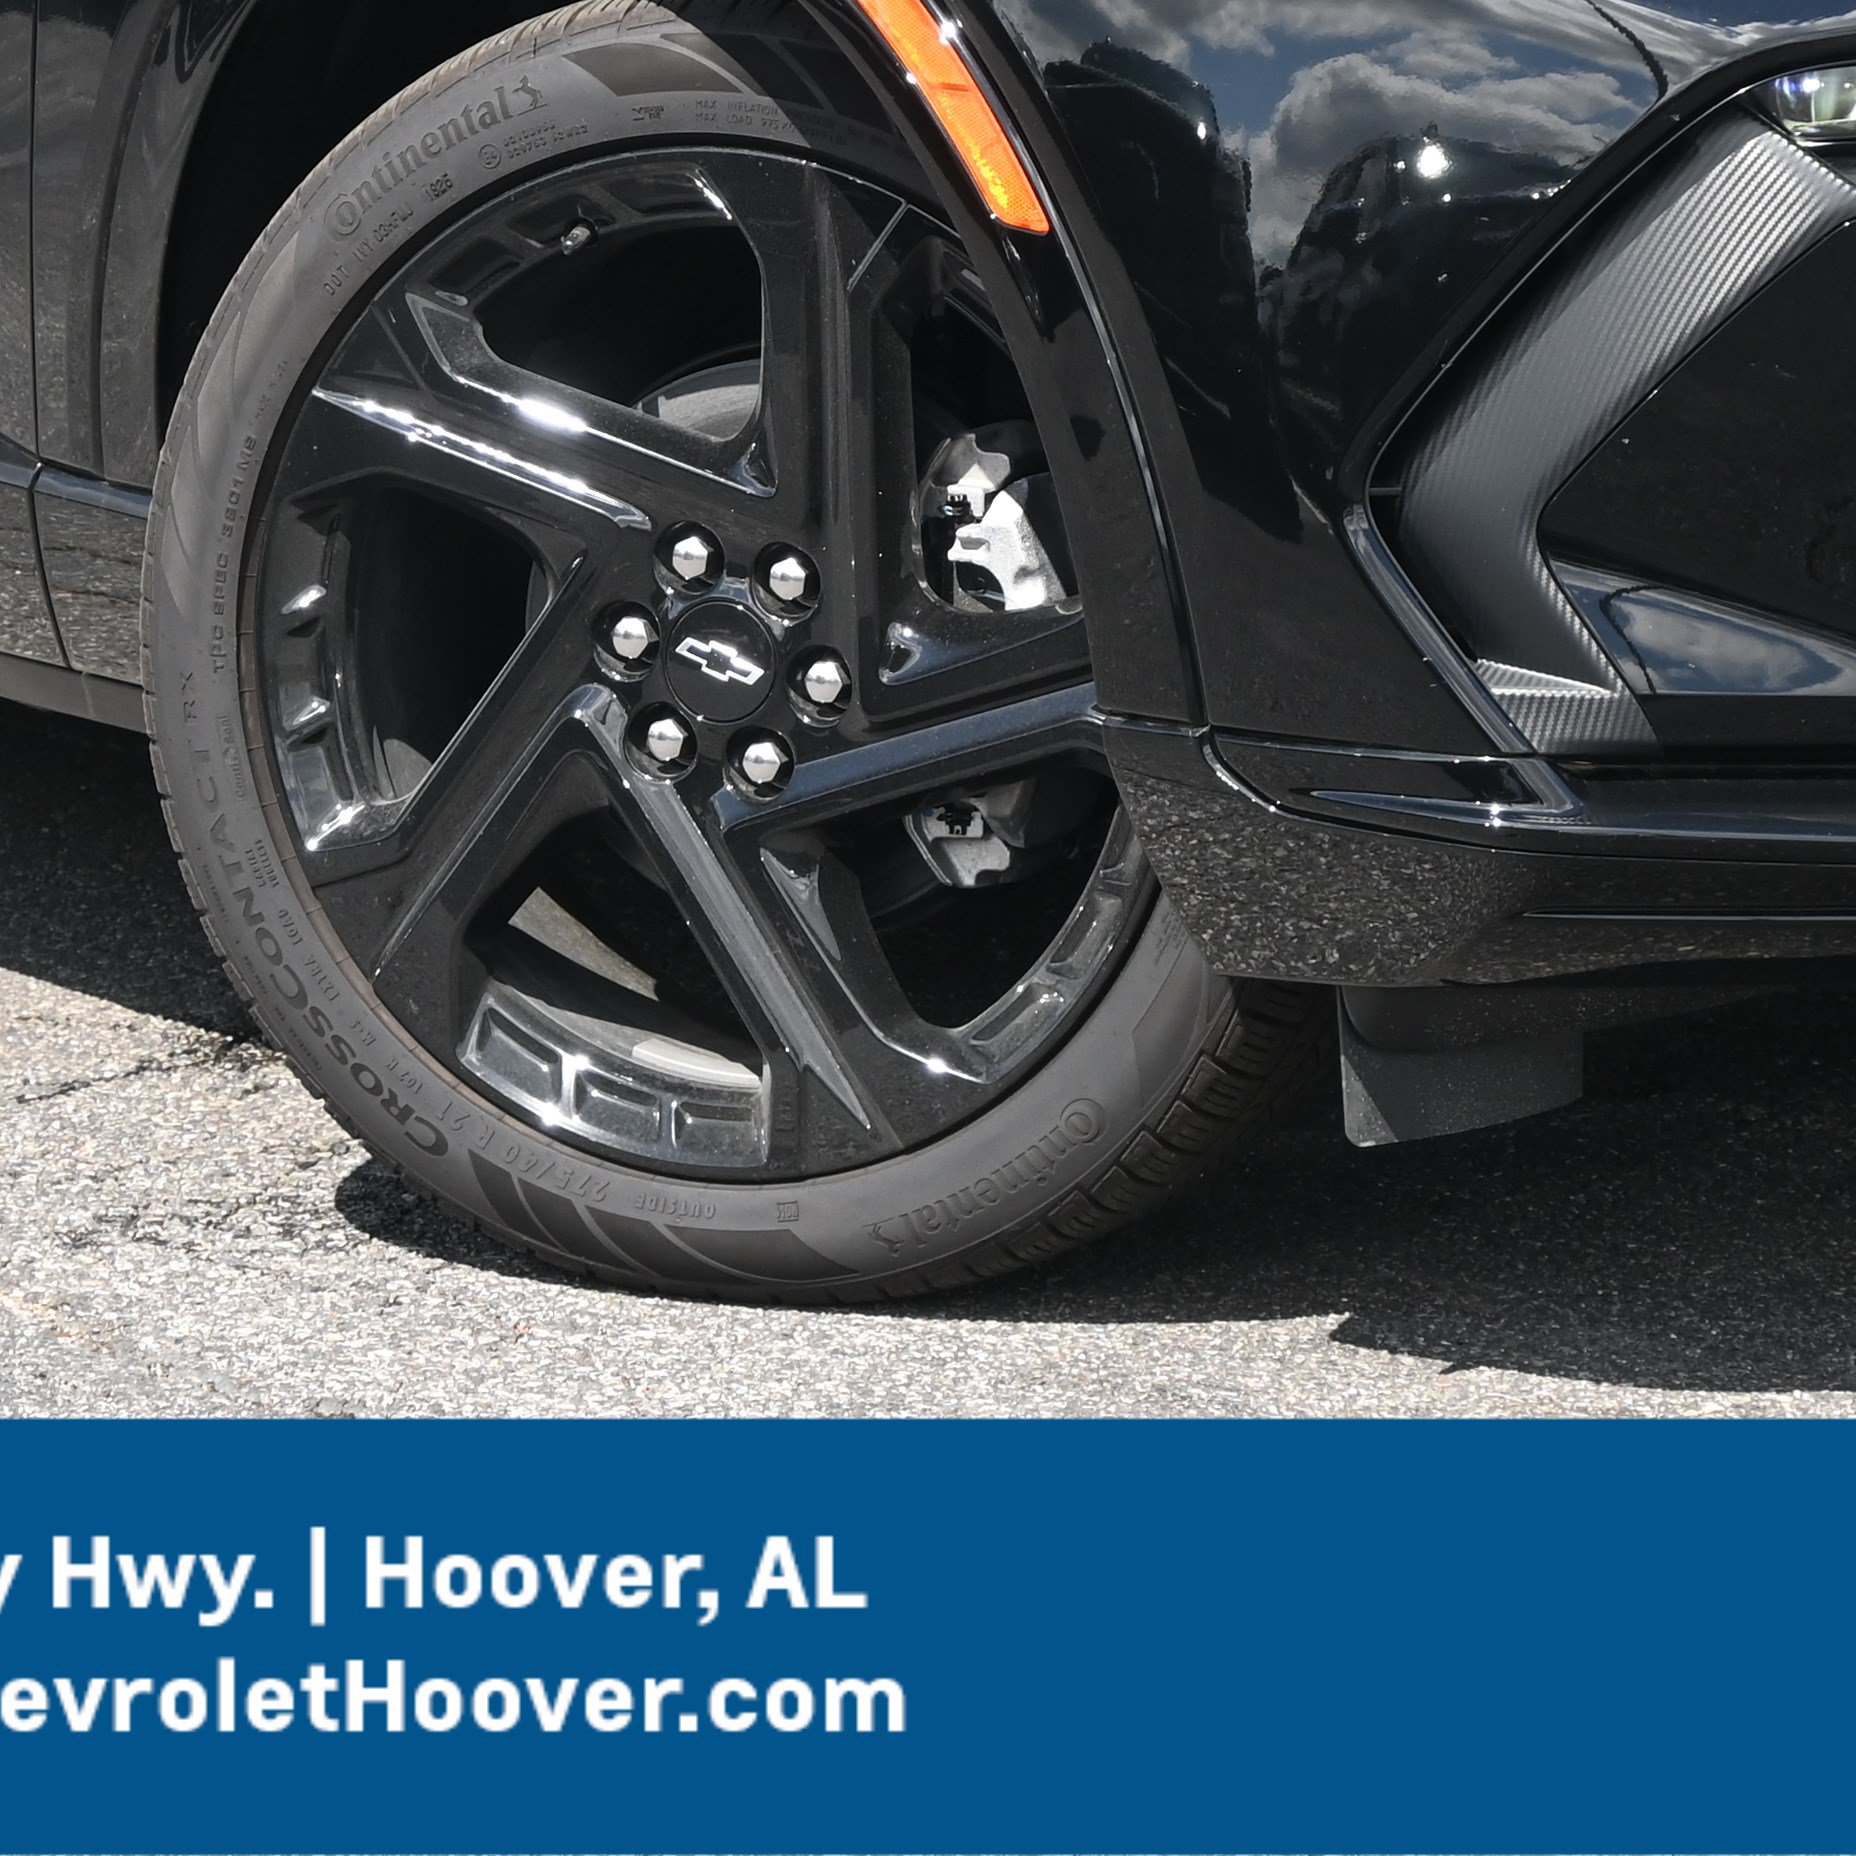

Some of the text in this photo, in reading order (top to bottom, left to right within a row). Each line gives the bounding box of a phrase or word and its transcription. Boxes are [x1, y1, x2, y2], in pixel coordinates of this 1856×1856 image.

[324, 85, 514, 236] Continental
[436, 1099, 472, 1132] 21
[502, 1145, 611, 1205] 275/40
[897, 1097, 1108, 1249] Continental
